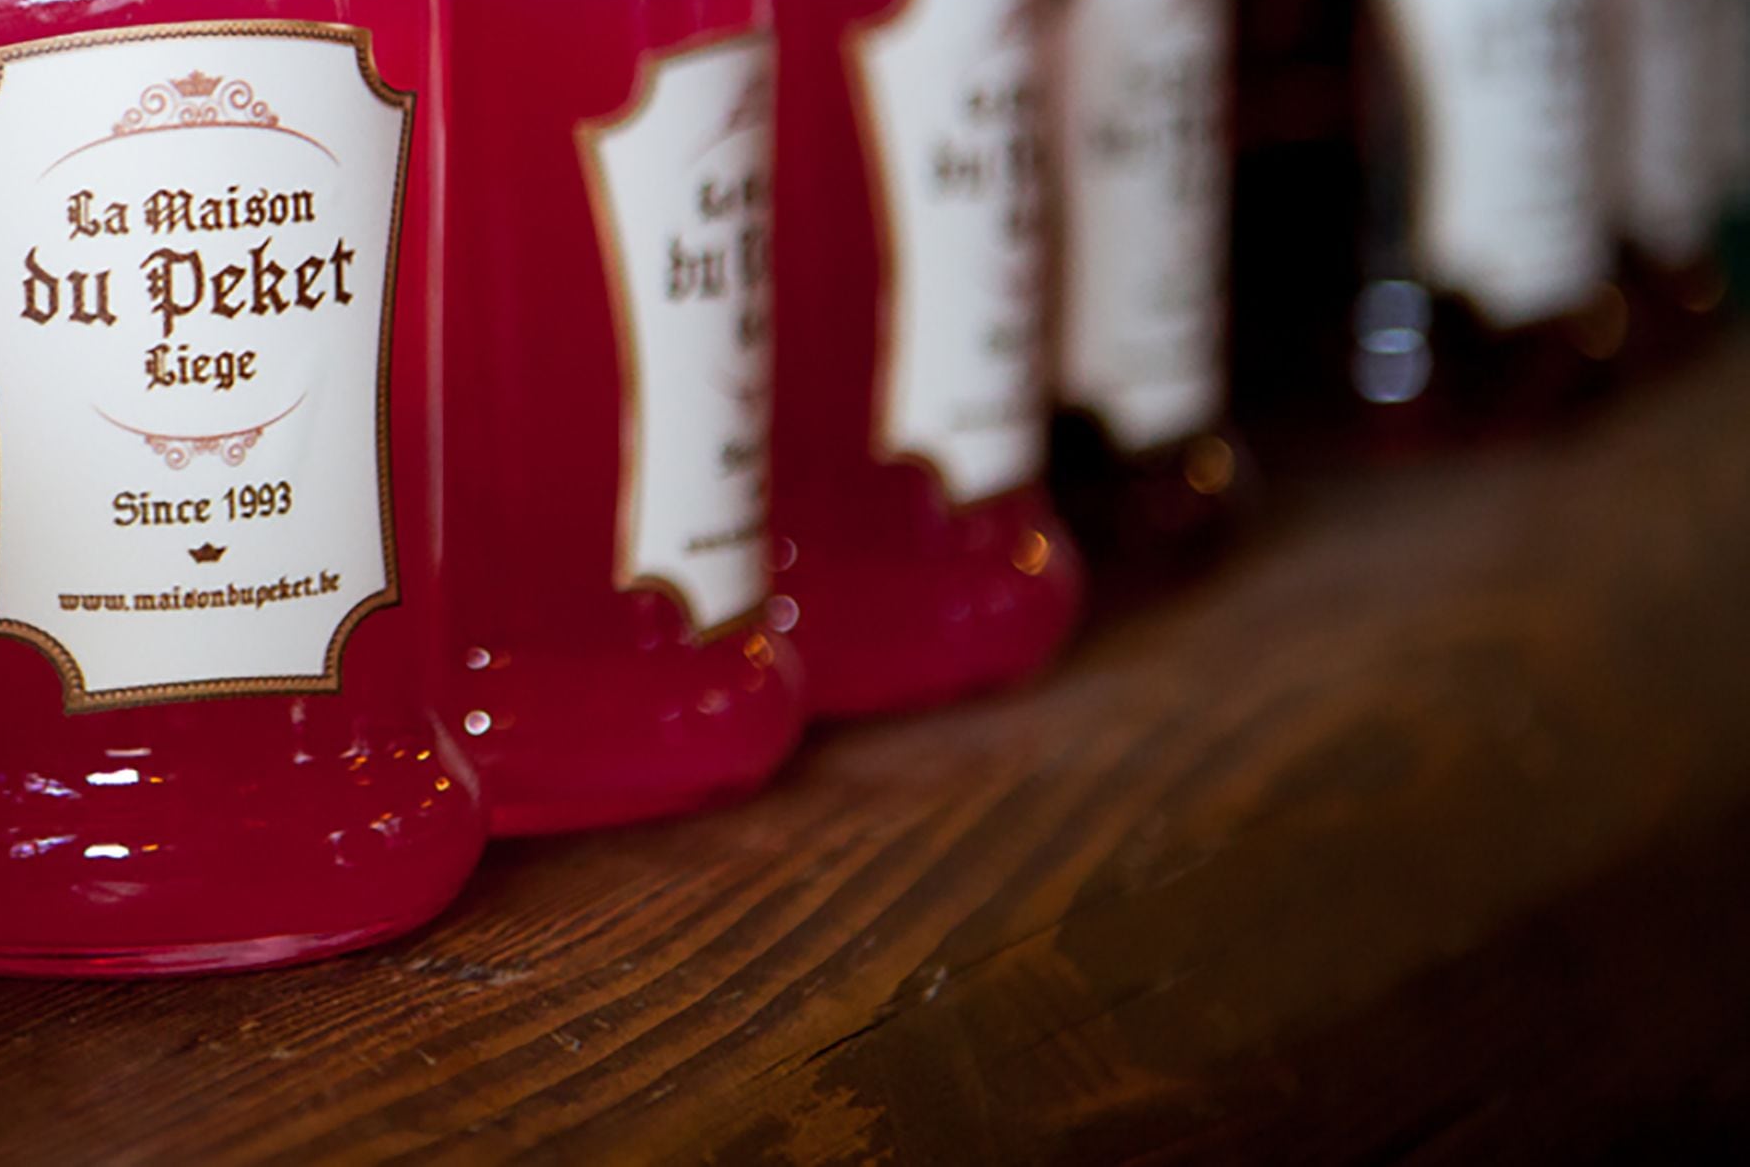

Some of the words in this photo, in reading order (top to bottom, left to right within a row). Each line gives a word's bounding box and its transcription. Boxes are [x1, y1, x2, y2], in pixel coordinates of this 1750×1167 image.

[66, 189, 130, 240] La
[143, 184, 316, 236] Maison
[19, 246, 118, 328] du
[139, 236, 356, 338] Peket
[144, 342, 257, 391] Liege
[112, 491, 212, 527] Since
[222, 480, 293, 522] 1993
